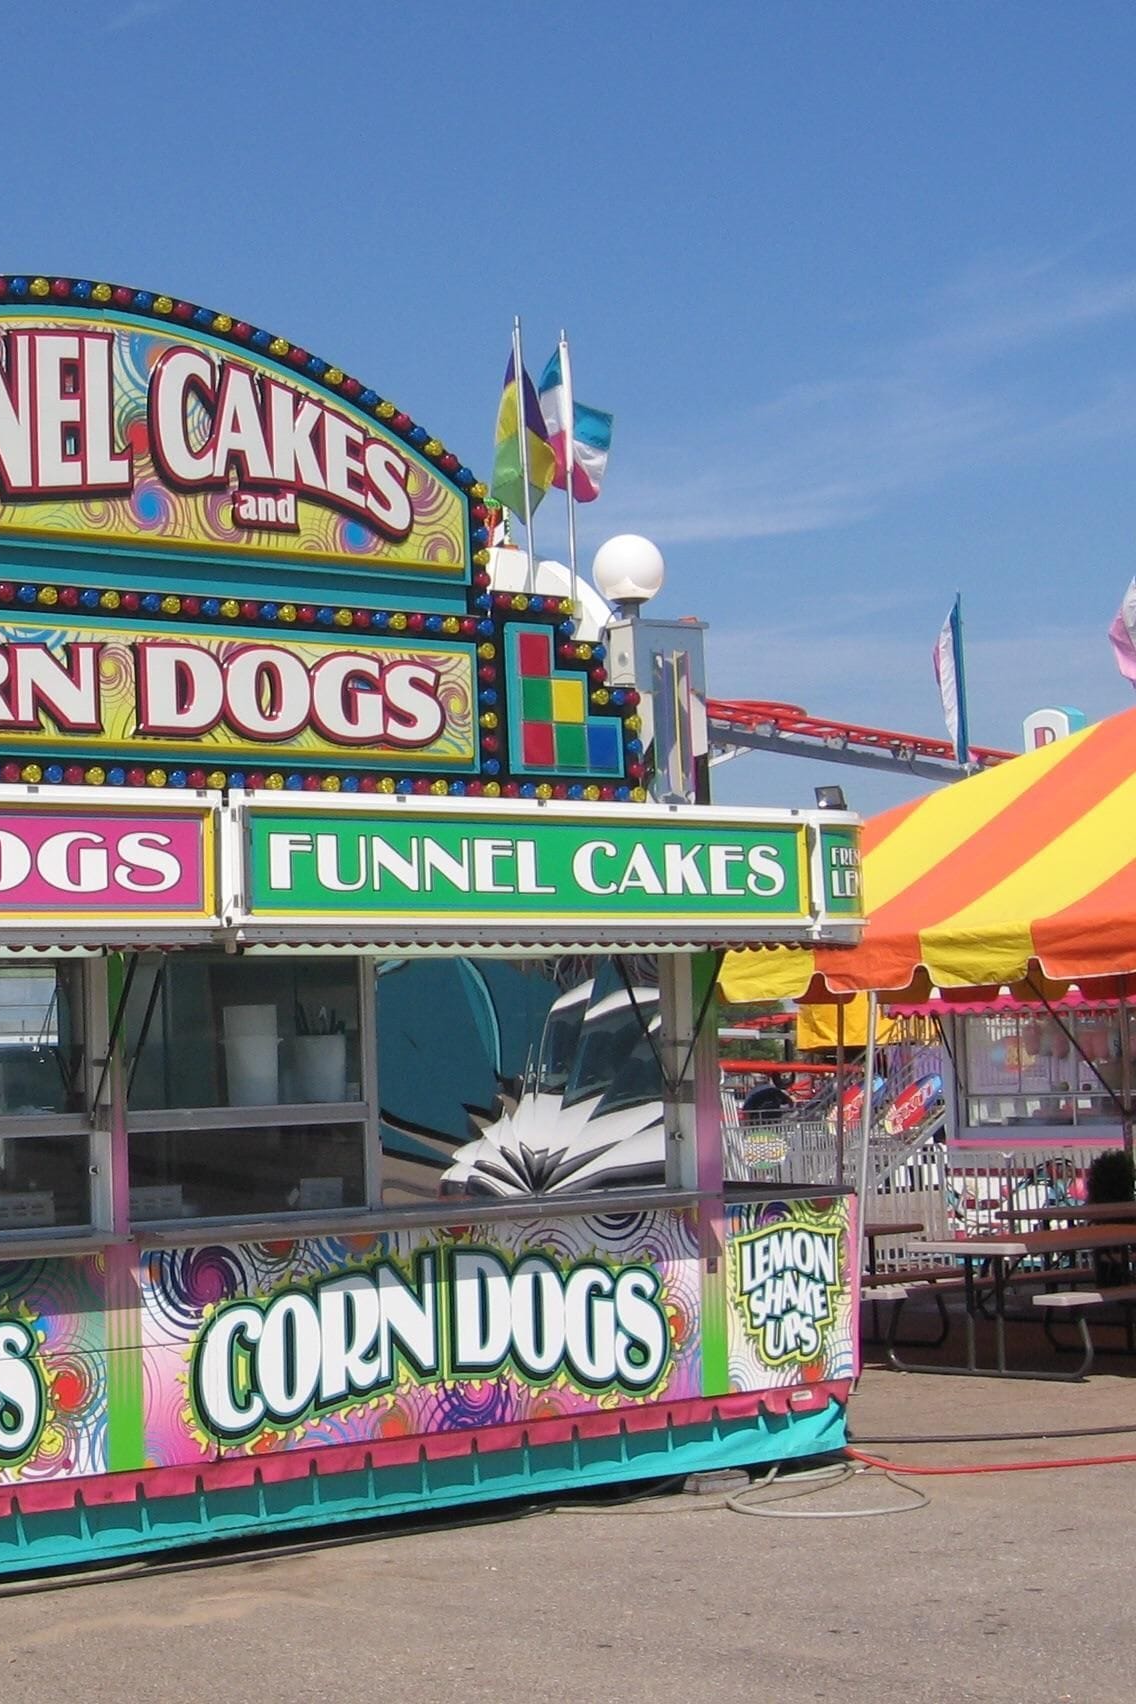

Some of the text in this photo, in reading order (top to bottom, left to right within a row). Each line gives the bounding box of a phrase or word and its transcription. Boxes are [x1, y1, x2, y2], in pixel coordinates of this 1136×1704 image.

[147, 346, 414, 541] CAKES
[235, 491, 300, 531] and
[139, 642, 445, 749] DOGS
[268, 832, 785, 896] FUNNEL CAKES
[740, 1229, 835, 1292] LEMON
[748, 1268, 828, 1327] SHAKE
[197, 1248, 666, 1435] CORN DOGS
[764, 1311, 818, 1358] UPS
